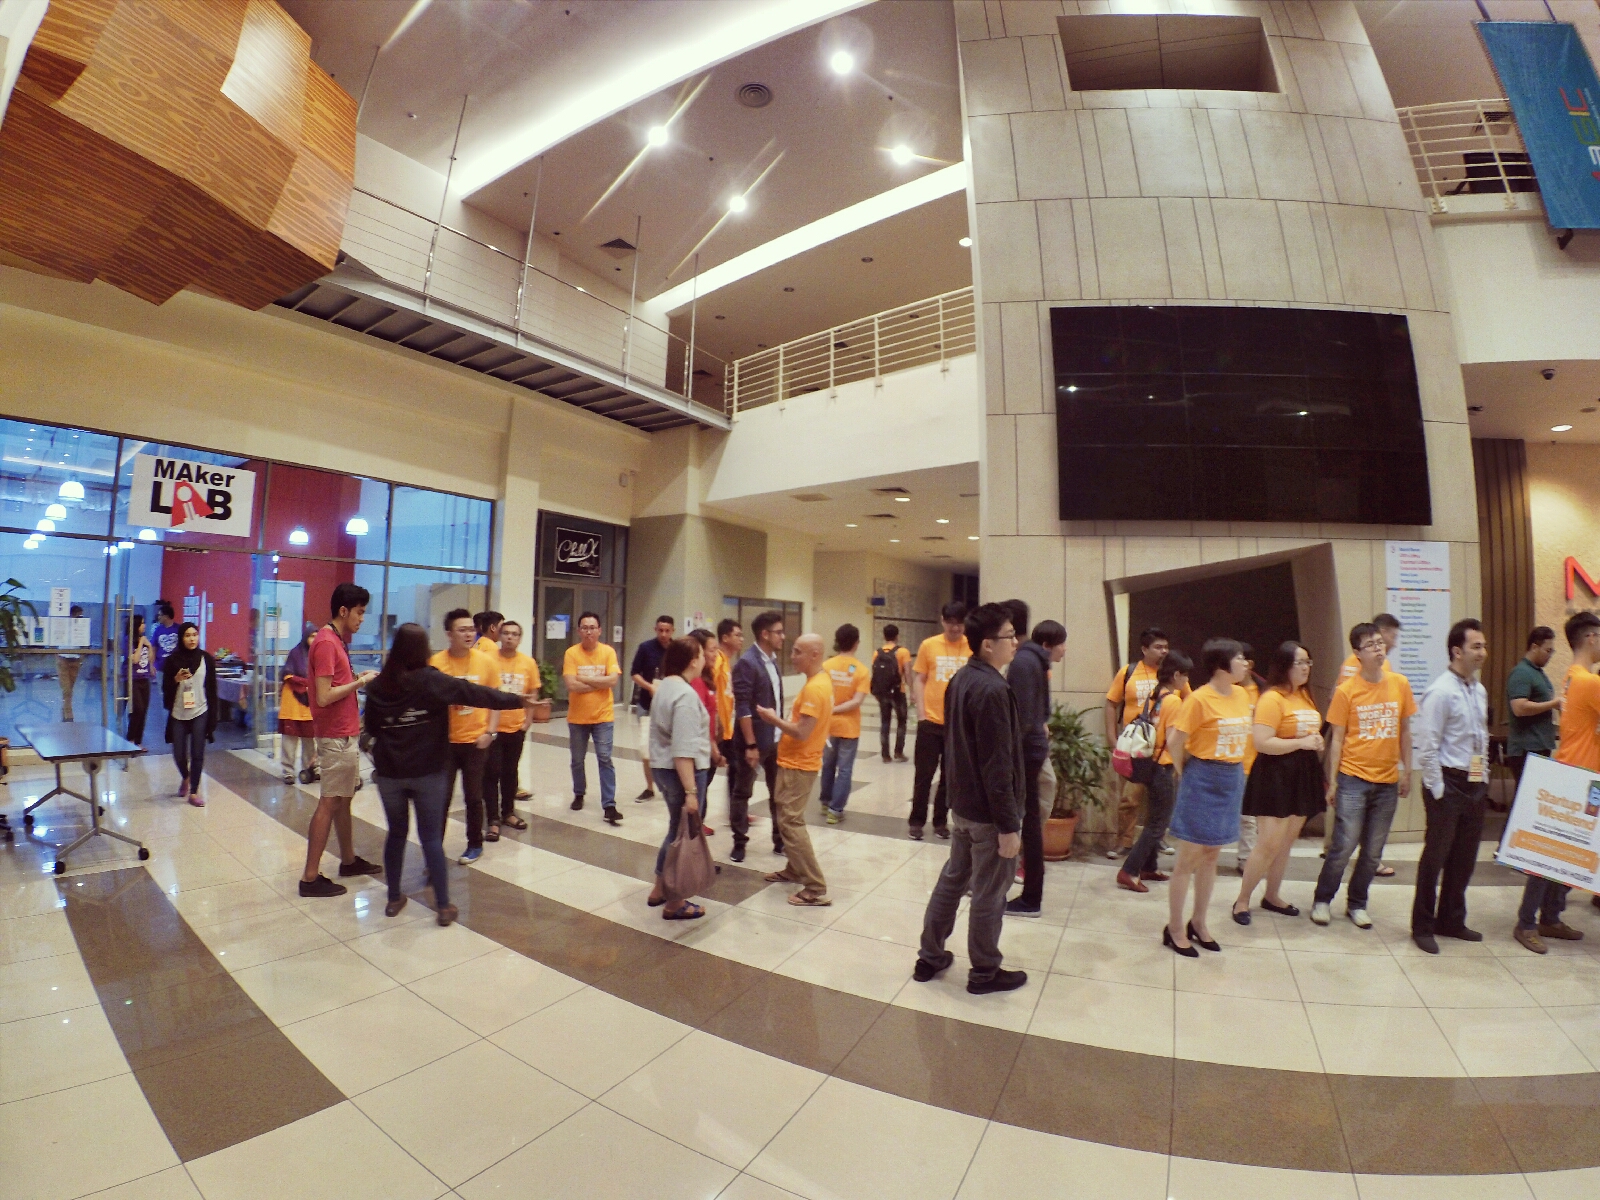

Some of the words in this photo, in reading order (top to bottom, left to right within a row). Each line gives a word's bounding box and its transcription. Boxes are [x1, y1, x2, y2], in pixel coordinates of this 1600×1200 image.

[153, 458, 236, 488] MAker
[1357, 703, 1384, 711] MAKING
[1358, 710, 1393, 719] WORLD
[1359, 718, 1399, 729] BETTER
[1359, 727, 1398, 740] PLACE
[1537, 788, 1583, 814] Startup
[1538, 802, 1598, 831] Weekend
